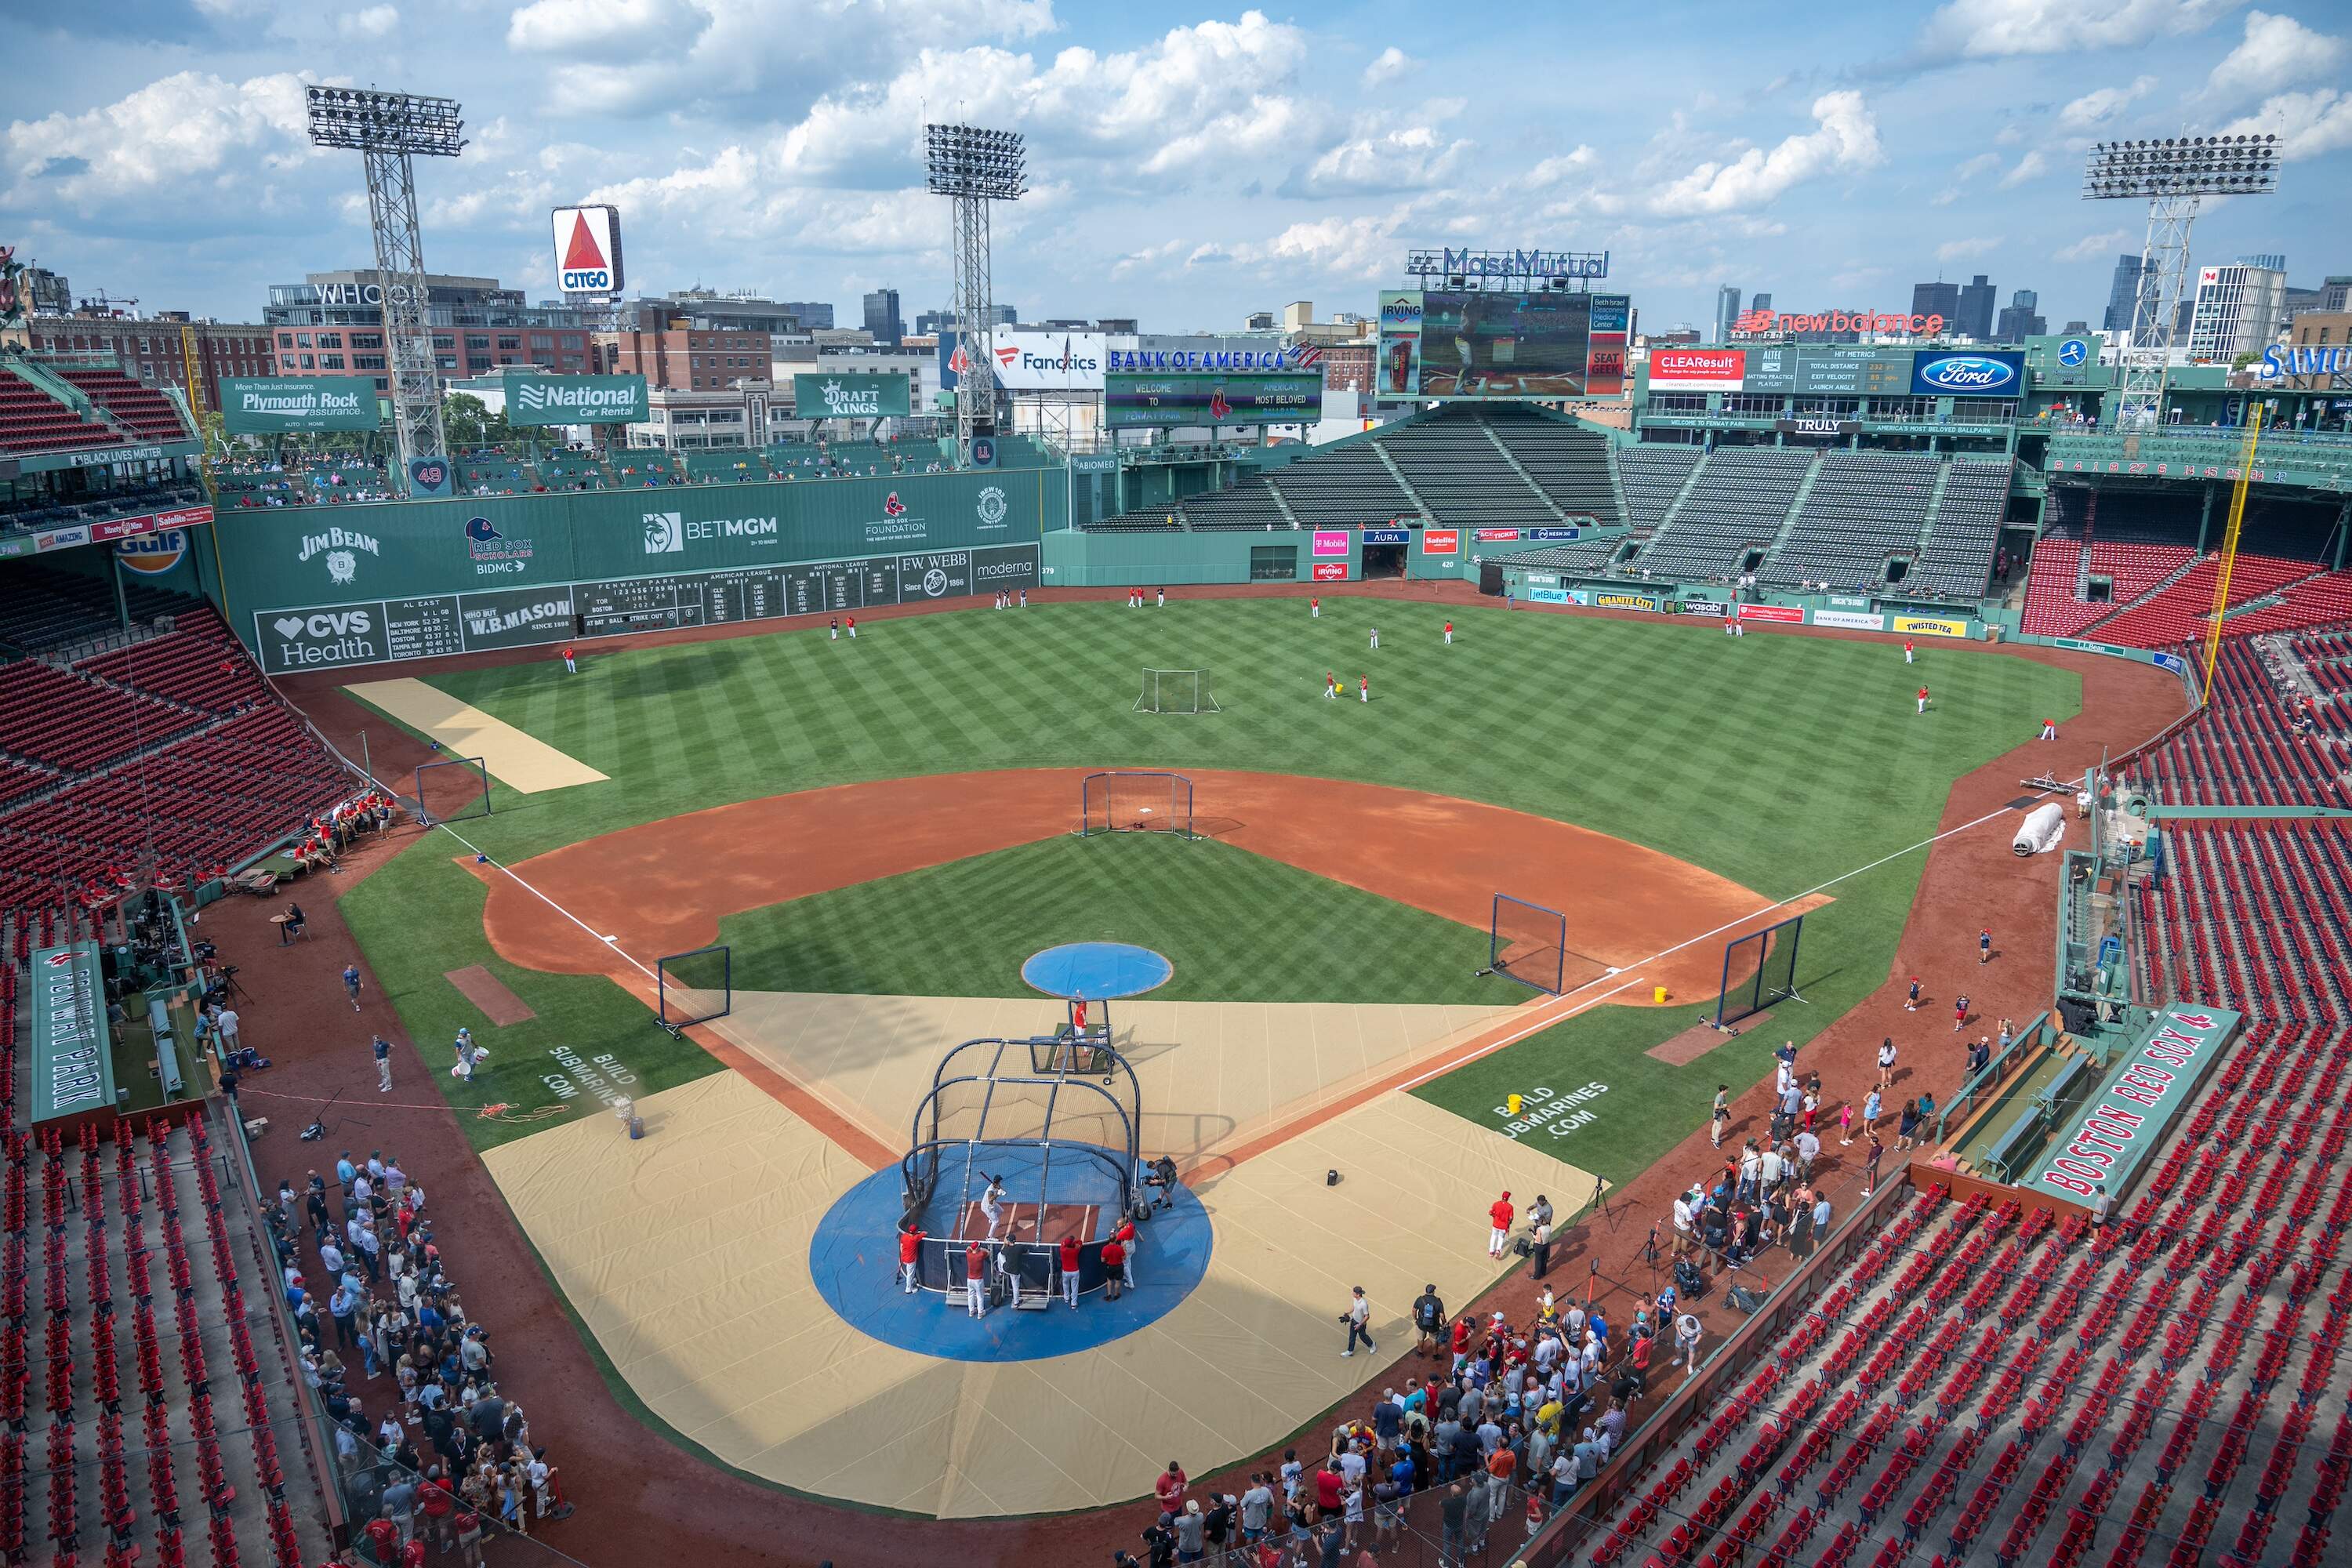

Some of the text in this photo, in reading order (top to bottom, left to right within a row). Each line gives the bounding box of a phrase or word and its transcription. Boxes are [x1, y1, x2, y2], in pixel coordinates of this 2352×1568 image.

[1442, 246, 1610, 278] MassMutual
[564, 270, 608, 289] CITGO
[1382, 305, 1421, 315] IRVING
[1023, 353, 1097, 370] Fanatics
[1110, 351, 1285, 368] BANK OF AMERICA
[1594, 353, 1620, 363] SEAT
[1661, 357, 1733, 368] CLEAResult
[1592, 364, 1619, 374] GEEK
[1937, 361, 2001, 385] Ford
[1135, 383, 1172, 394] WELCOME
[242, 392, 358, 411] Plymouth Rock
[824, 390, 879, 405] DRAFT
[1149, 397, 1159, 407] TO
[1255, 395, 1306, 405] MOST BELOVED
[309, 407, 361, 416] assurance
[579, 406, 633, 417] Car Rental
[833, 401, 879, 414] KINGS
[1795, 419, 1841, 431] TRULY
[82, 447, 162, 465] BLACK LIVES MATTER
[1079, 459, 1115, 470] ABIOMED
[418, 467, 442, 484] 49
[2073, 460, 2287, 483] 4 27 14 34 42
[158, 514, 187, 526] Safelite
[686, 517, 777, 539] BETMGM
[866, 523, 927, 535] FOUNDATION
[1494, 530, 1518, 539] TICKET
[116, 532, 181, 554] Gulf
[298, 526, 380, 563] JIM BEAM
[474, 539, 533, 552] RED SOX
[474, 549, 533, 561] SCHOLARS
[927, 553, 967, 568] WEBB
[476, 562, 514, 575] BIDMC
[978, 561, 1033, 576] moderna
[598, 581, 641, 590] FENWAY
[904, 578, 964, 592] Since 1866
[1533, 590, 1563, 601] jetBlue
[1598, 595, 1635, 605] GRANITE
[1635, 596, 1655, 609] CITY
[1831, 597, 1853, 607] DICK'S
[1686, 602, 1722, 612] wasabi
[463, 609, 497, 620] WHO BUT
[629, 614, 649, 622] STRIKE
[307, 610, 371, 638] CVS
[531, 621, 554, 630] SINCE
[1907, 622, 1938, 631] TWISTED
[1939, 625, 1952, 634] TEA
[390, 627, 422, 636] BALTIMORE
[281, 636, 376, 666] Health
[393, 650, 422, 659] TORONTO
[49, 968, 101, 1110] FENWAY PARK
[592, 1053, 637, 1084] BUILD
[549, 1046, 617, 1106] SUBMARINE
[539, 1074, 580, 1099] .COM
[1502, 1081, 1609, 1140] UBMARINES
[2042, 1025, 2206, 1197] BOSTON RED SOX
[1548, 1109, 1599, 1140] .COM
